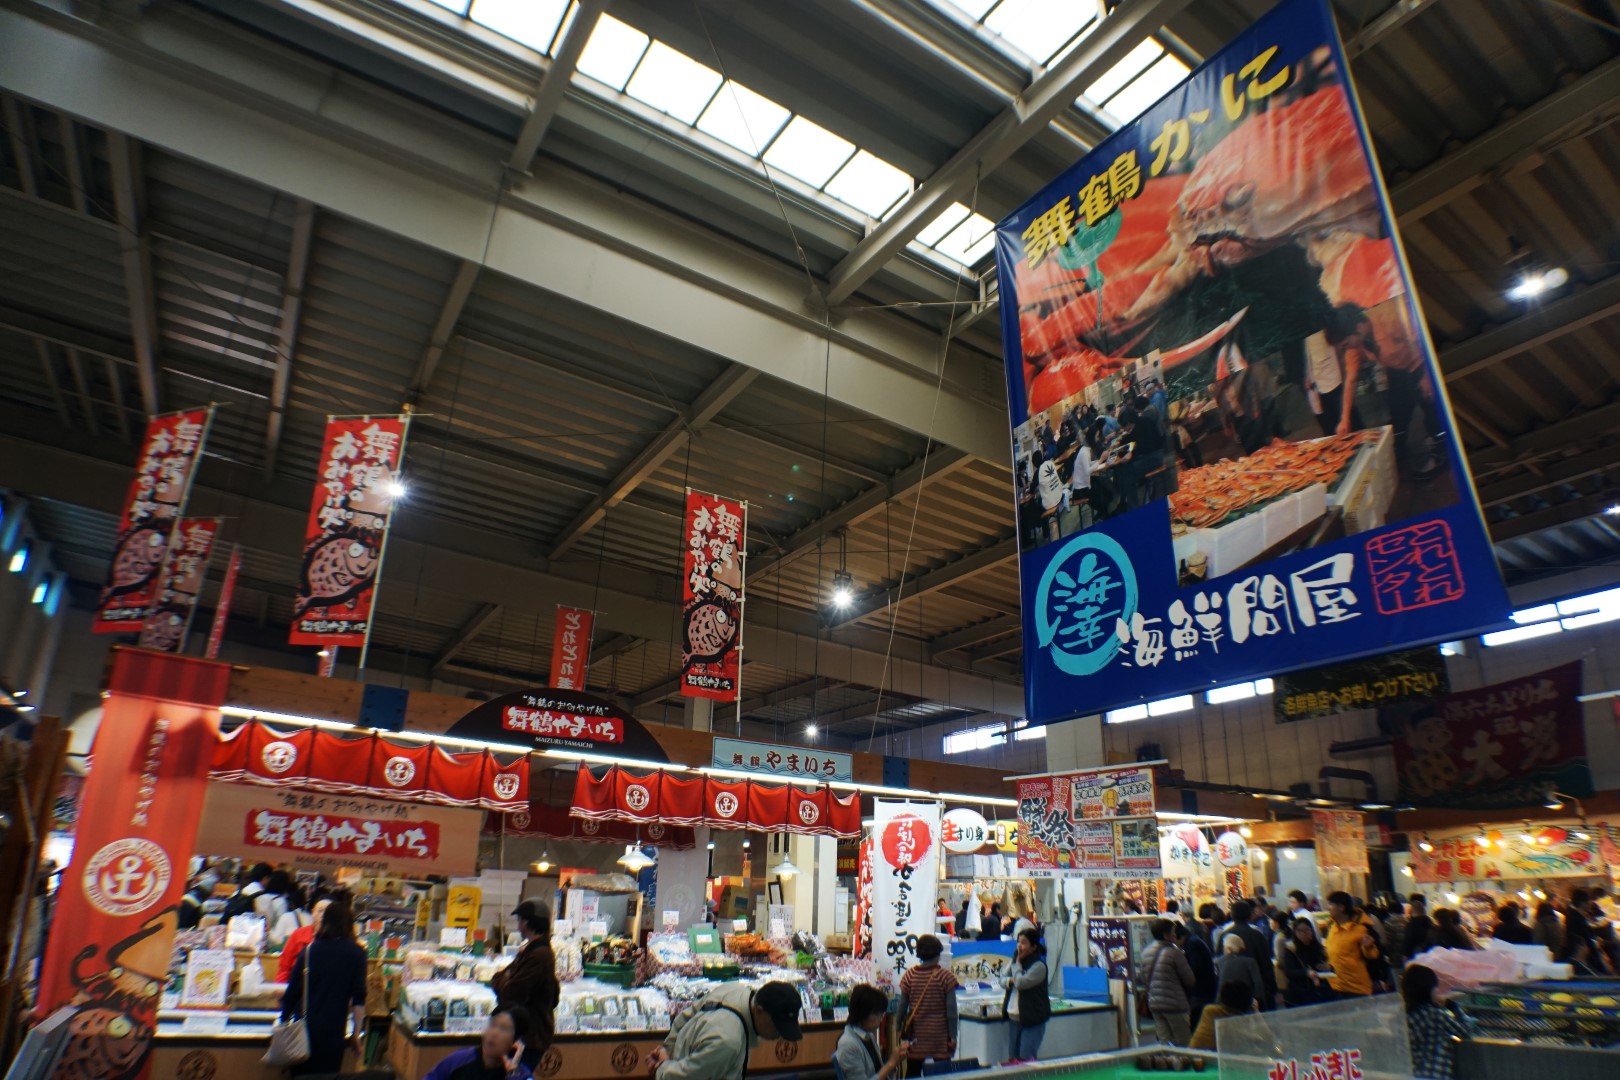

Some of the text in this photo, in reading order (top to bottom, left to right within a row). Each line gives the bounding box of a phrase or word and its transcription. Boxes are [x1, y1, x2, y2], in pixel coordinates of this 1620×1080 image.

[1021, 45, 1290, 269] 舞鶴かに
[319, 430, 362, 530] おみやげ処
[689, 504, 716, 594] おみやげ処
[709, 503, 742, 574] 舞鶴の
[1372, 534, 1406, 611] センター
[1410, 524, 1462, 601] とれとれ
[1115, 552, 1363, 668] 海鮮問屋
[507, 706, 616, 741] 舞鶴やまいち
[534, 736, 594, 749] MAIZURU YAMAICHI
[255, 810, 428, 856] 舞鶴やまいち
[941, 818, 984, 844] 生すり身
